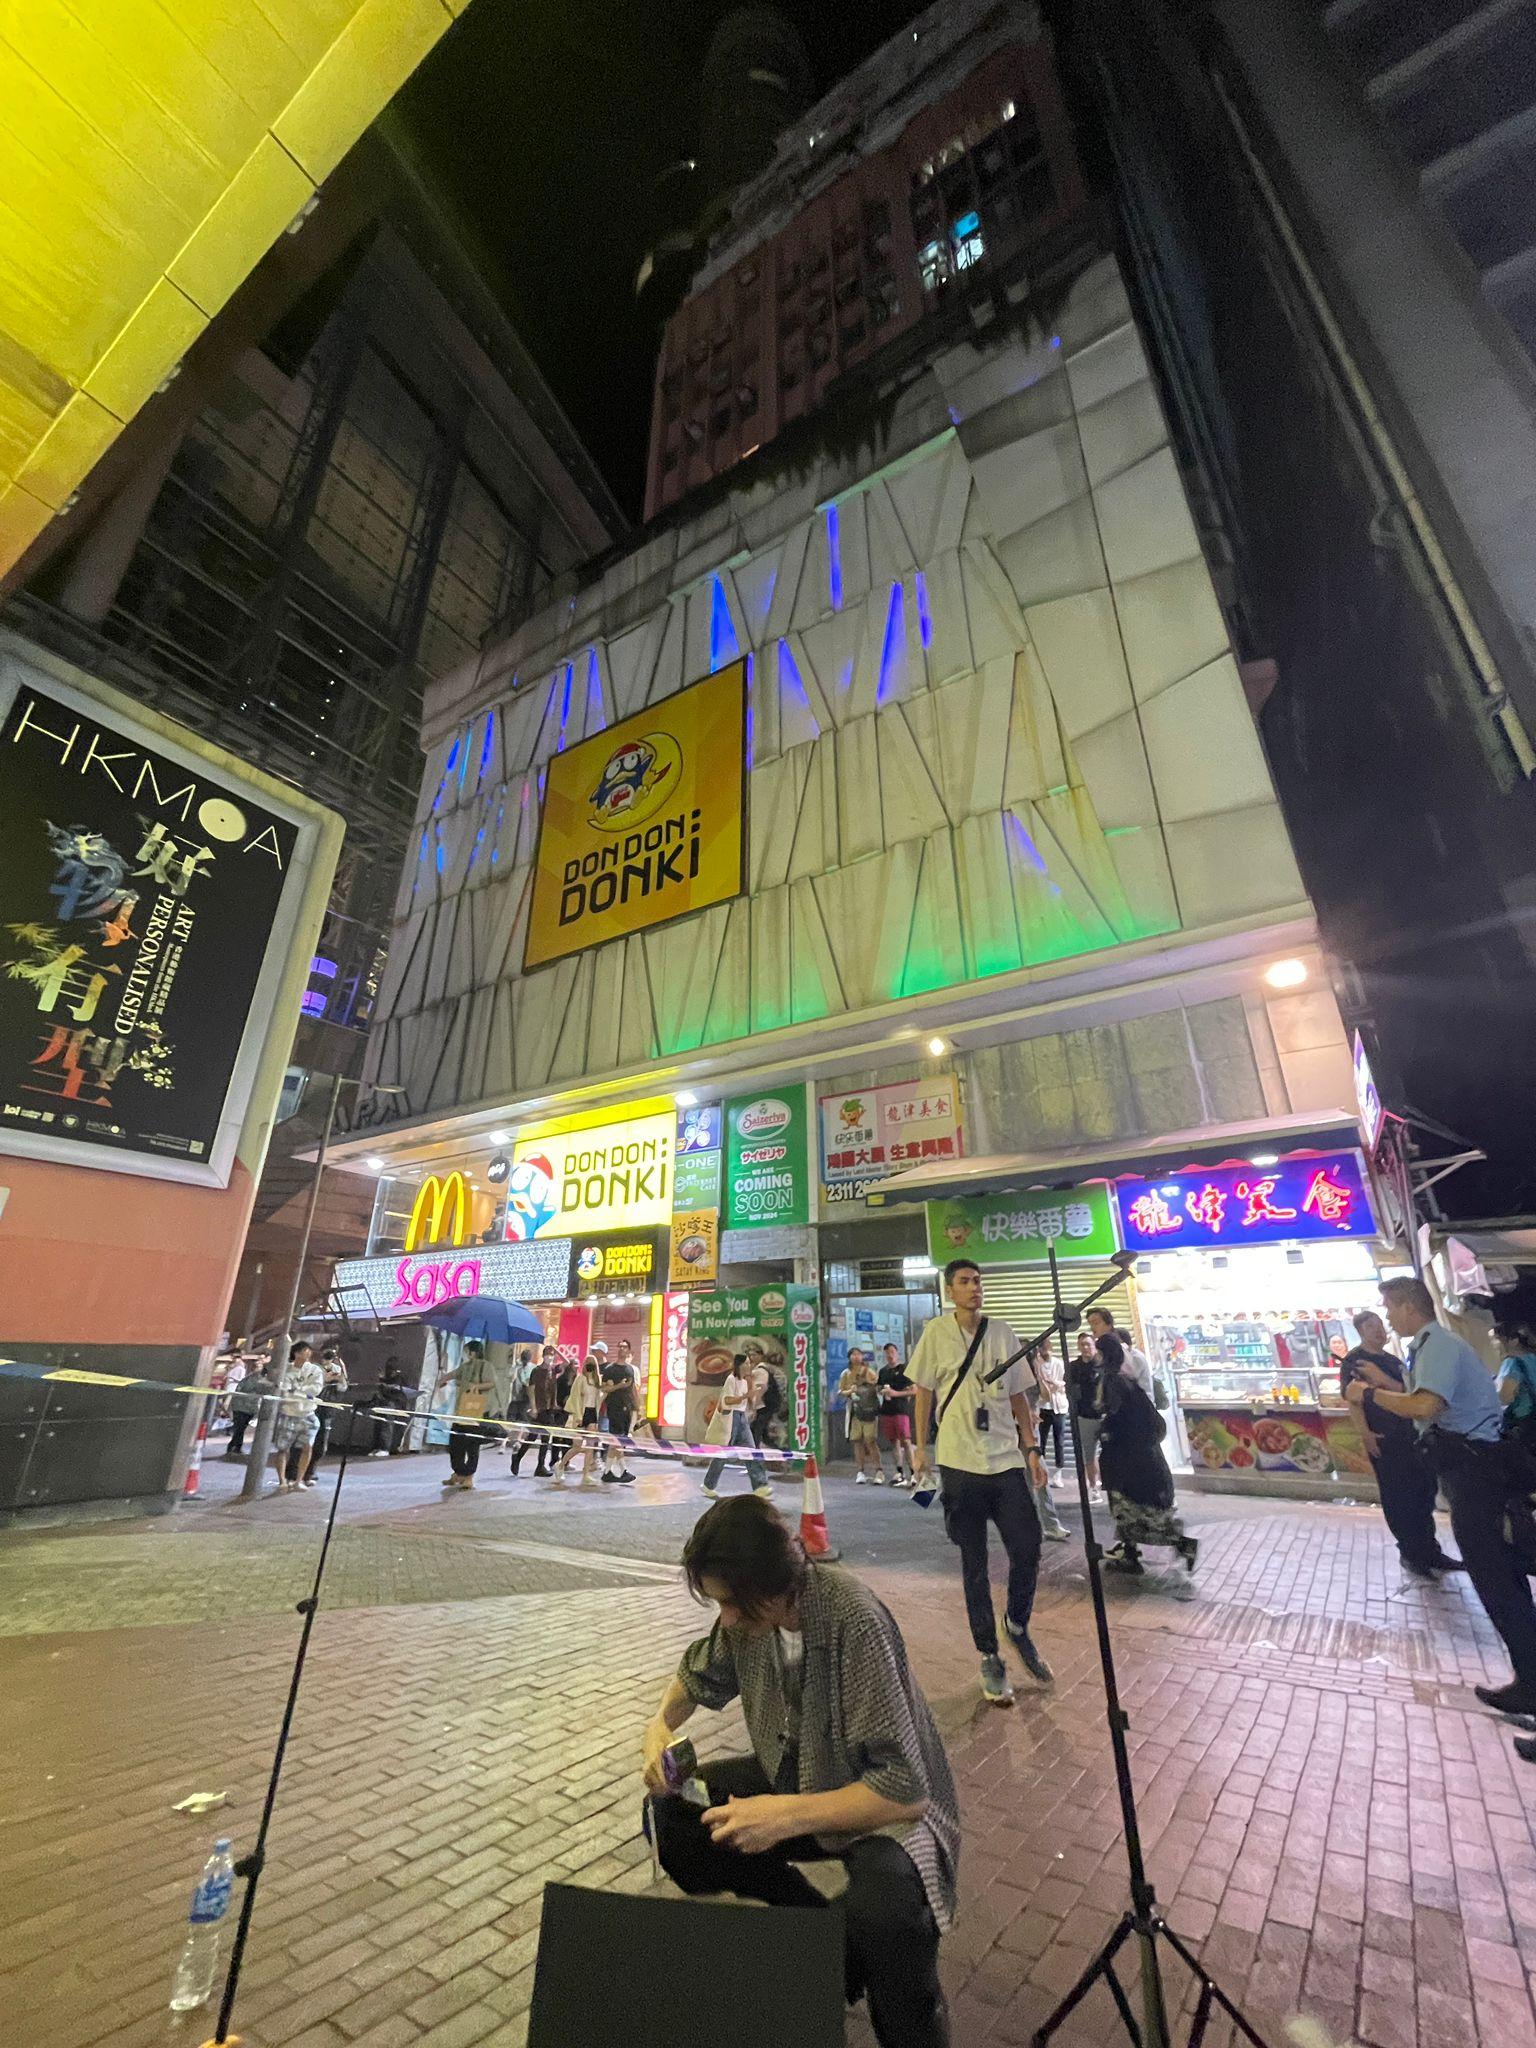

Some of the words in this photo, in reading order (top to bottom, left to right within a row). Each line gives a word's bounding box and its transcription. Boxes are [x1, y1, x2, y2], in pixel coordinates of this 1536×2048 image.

[563, 841, 618, 886] DON
[172, 902, 196, 943] ART
[114, 894, 176, 1035] PERSONALISED
[564, 1148, 607, 1175] DON
[742, 1147, 786, 1164] サイゼリヤ
[734, 1173, 793, 1192] COMING
[735, 1188, 793, 1214] SOON
[981, 1203, 1093, 1244] 快樂番薯
[606, 1246, 626, 1258] DON
[691, 1299, 722, 1314] See
[727, 1298, 749, 1312] You
[706, 1316, 756, 1329] November
[794, 1333, 809, 1450] サイゼリヤ
